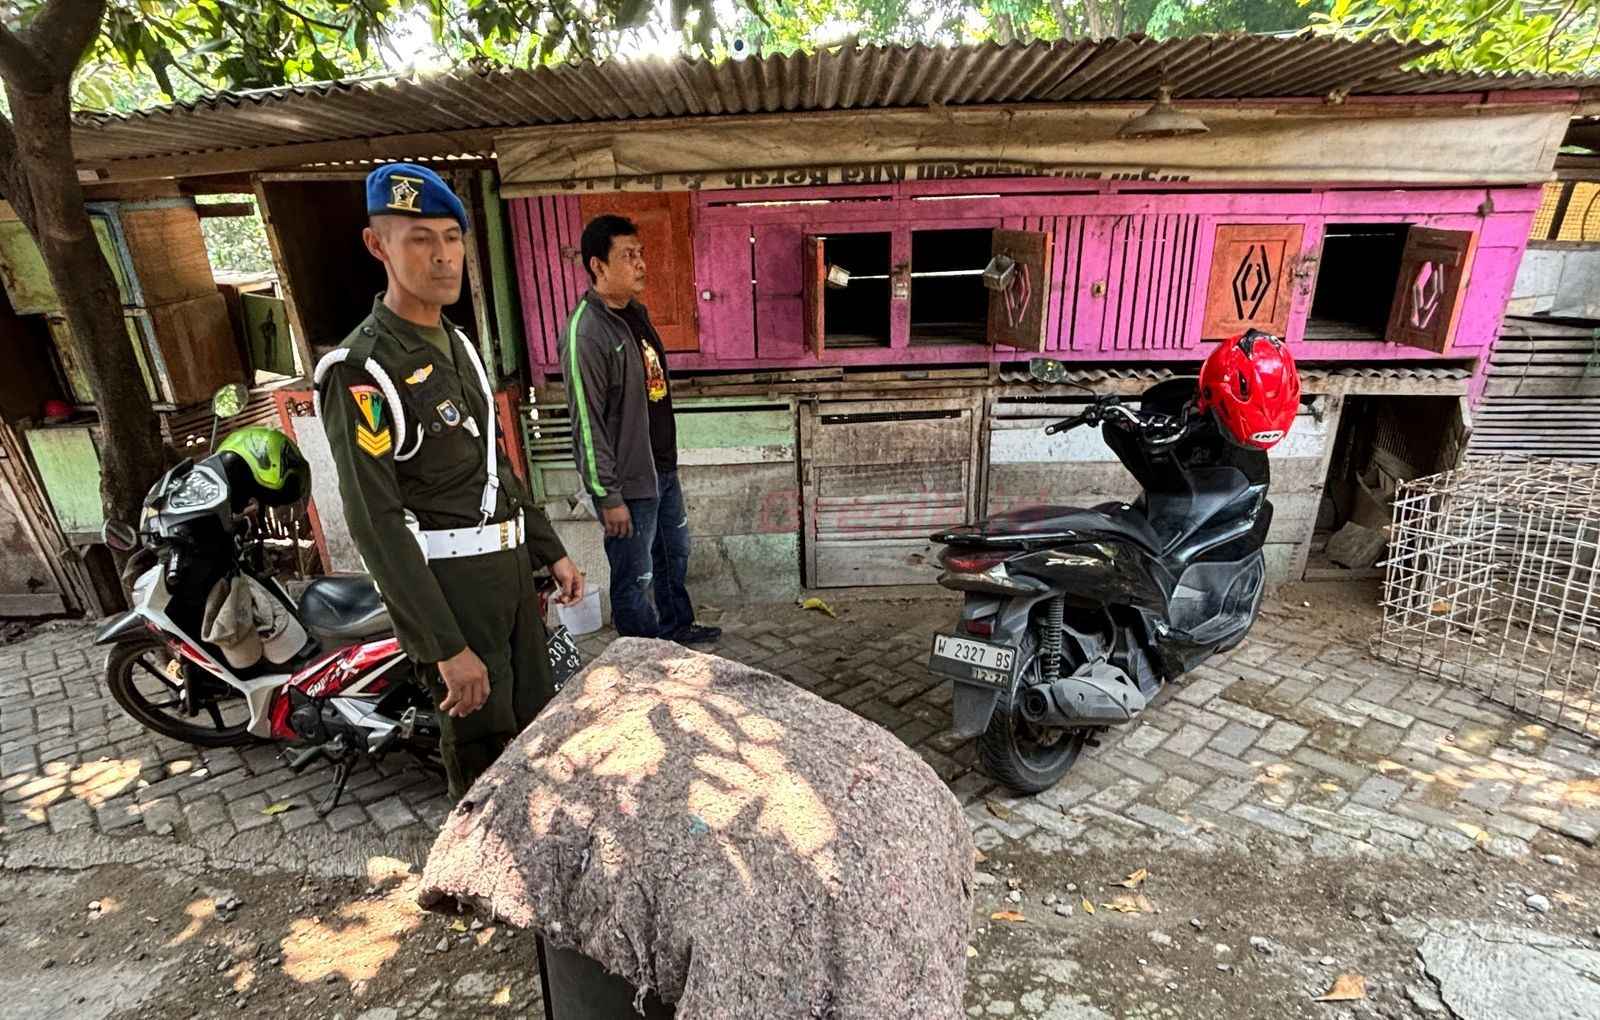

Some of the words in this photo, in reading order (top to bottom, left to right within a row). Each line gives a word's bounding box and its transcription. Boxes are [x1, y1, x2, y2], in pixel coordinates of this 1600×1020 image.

[937, 639, 946, 655] W
[954, 643, 986, 663] 2327
[995, 652, 1011, 669] BS
